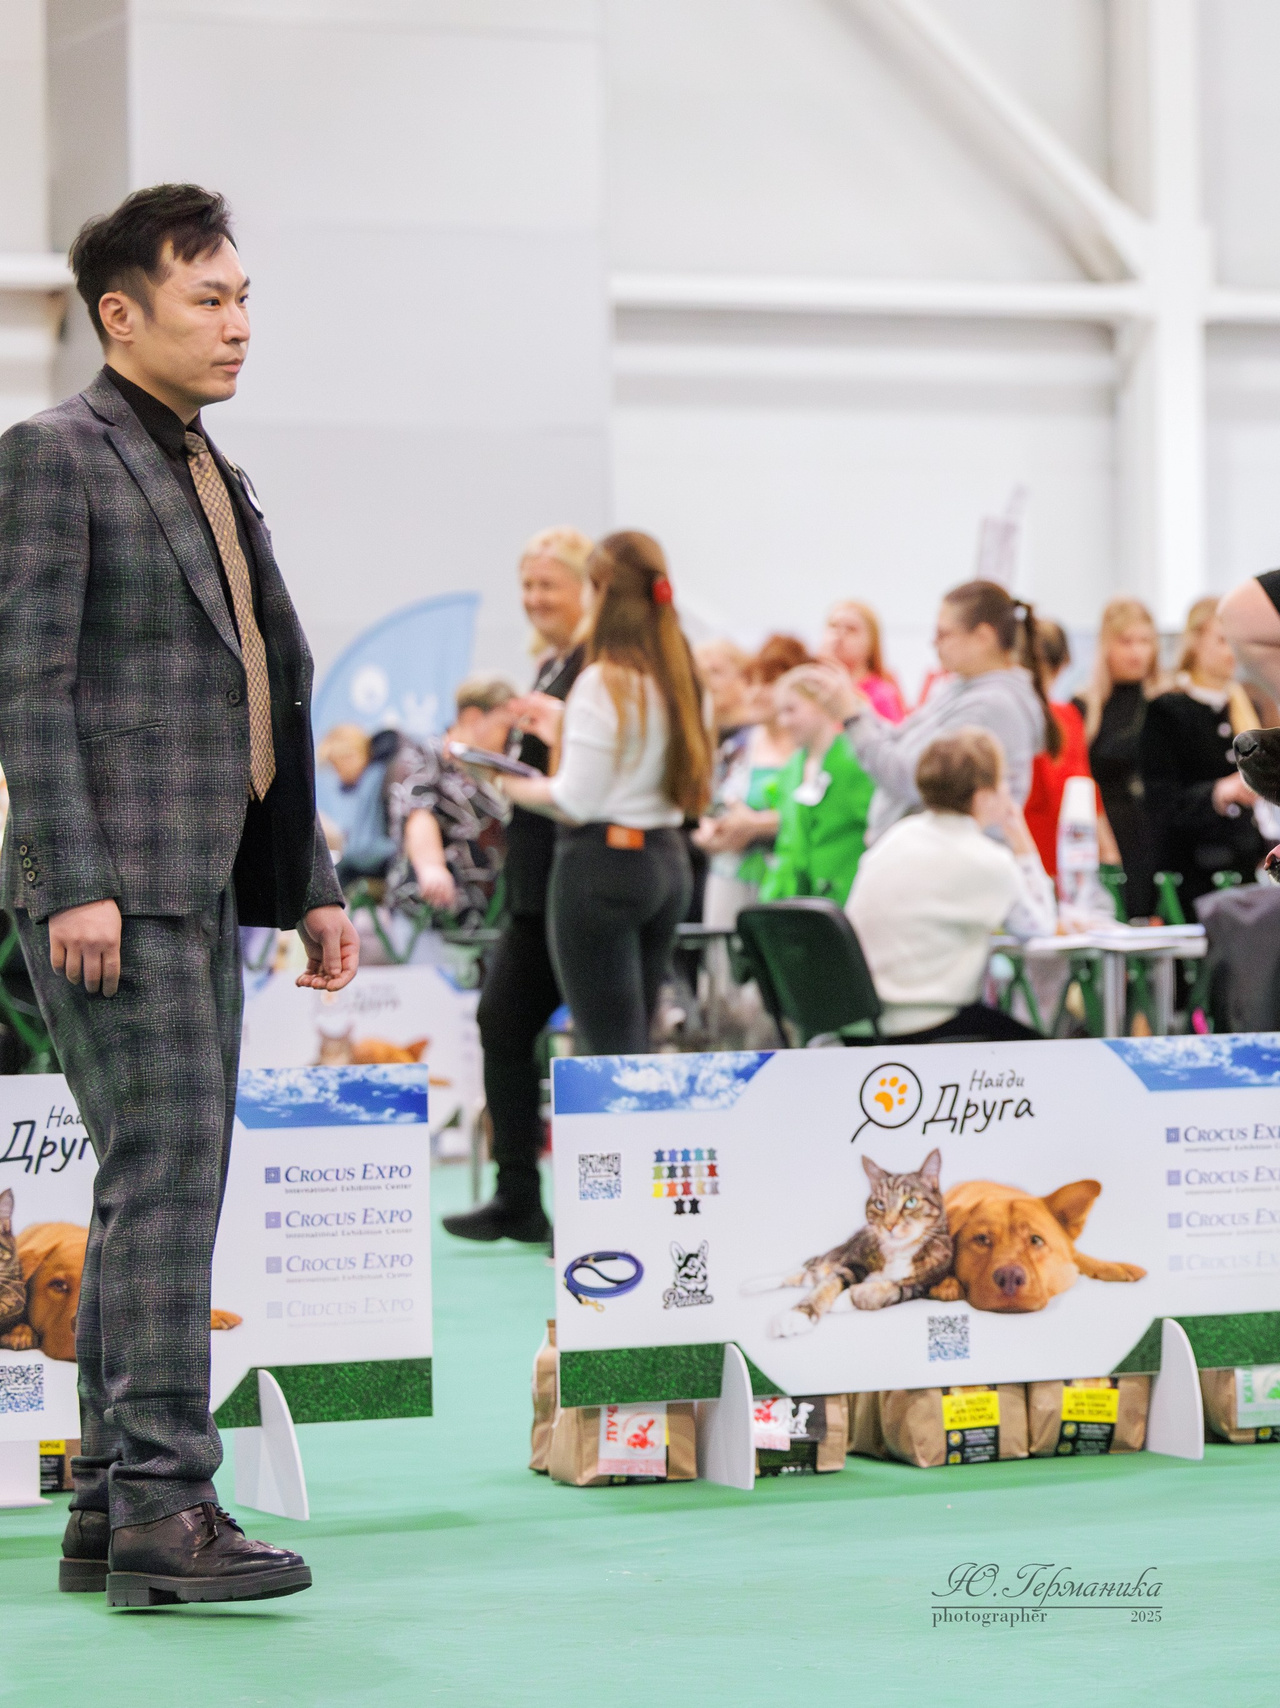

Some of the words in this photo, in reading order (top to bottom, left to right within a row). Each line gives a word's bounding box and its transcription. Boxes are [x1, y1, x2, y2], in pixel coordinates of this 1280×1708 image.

[968, 1069, 1025, 1092] Найди
[921, 1084, 1035, 1135] Друга
[361, 1162, 412, 1181] EXPO
[361, 1207, 413, 1225] EXPO
